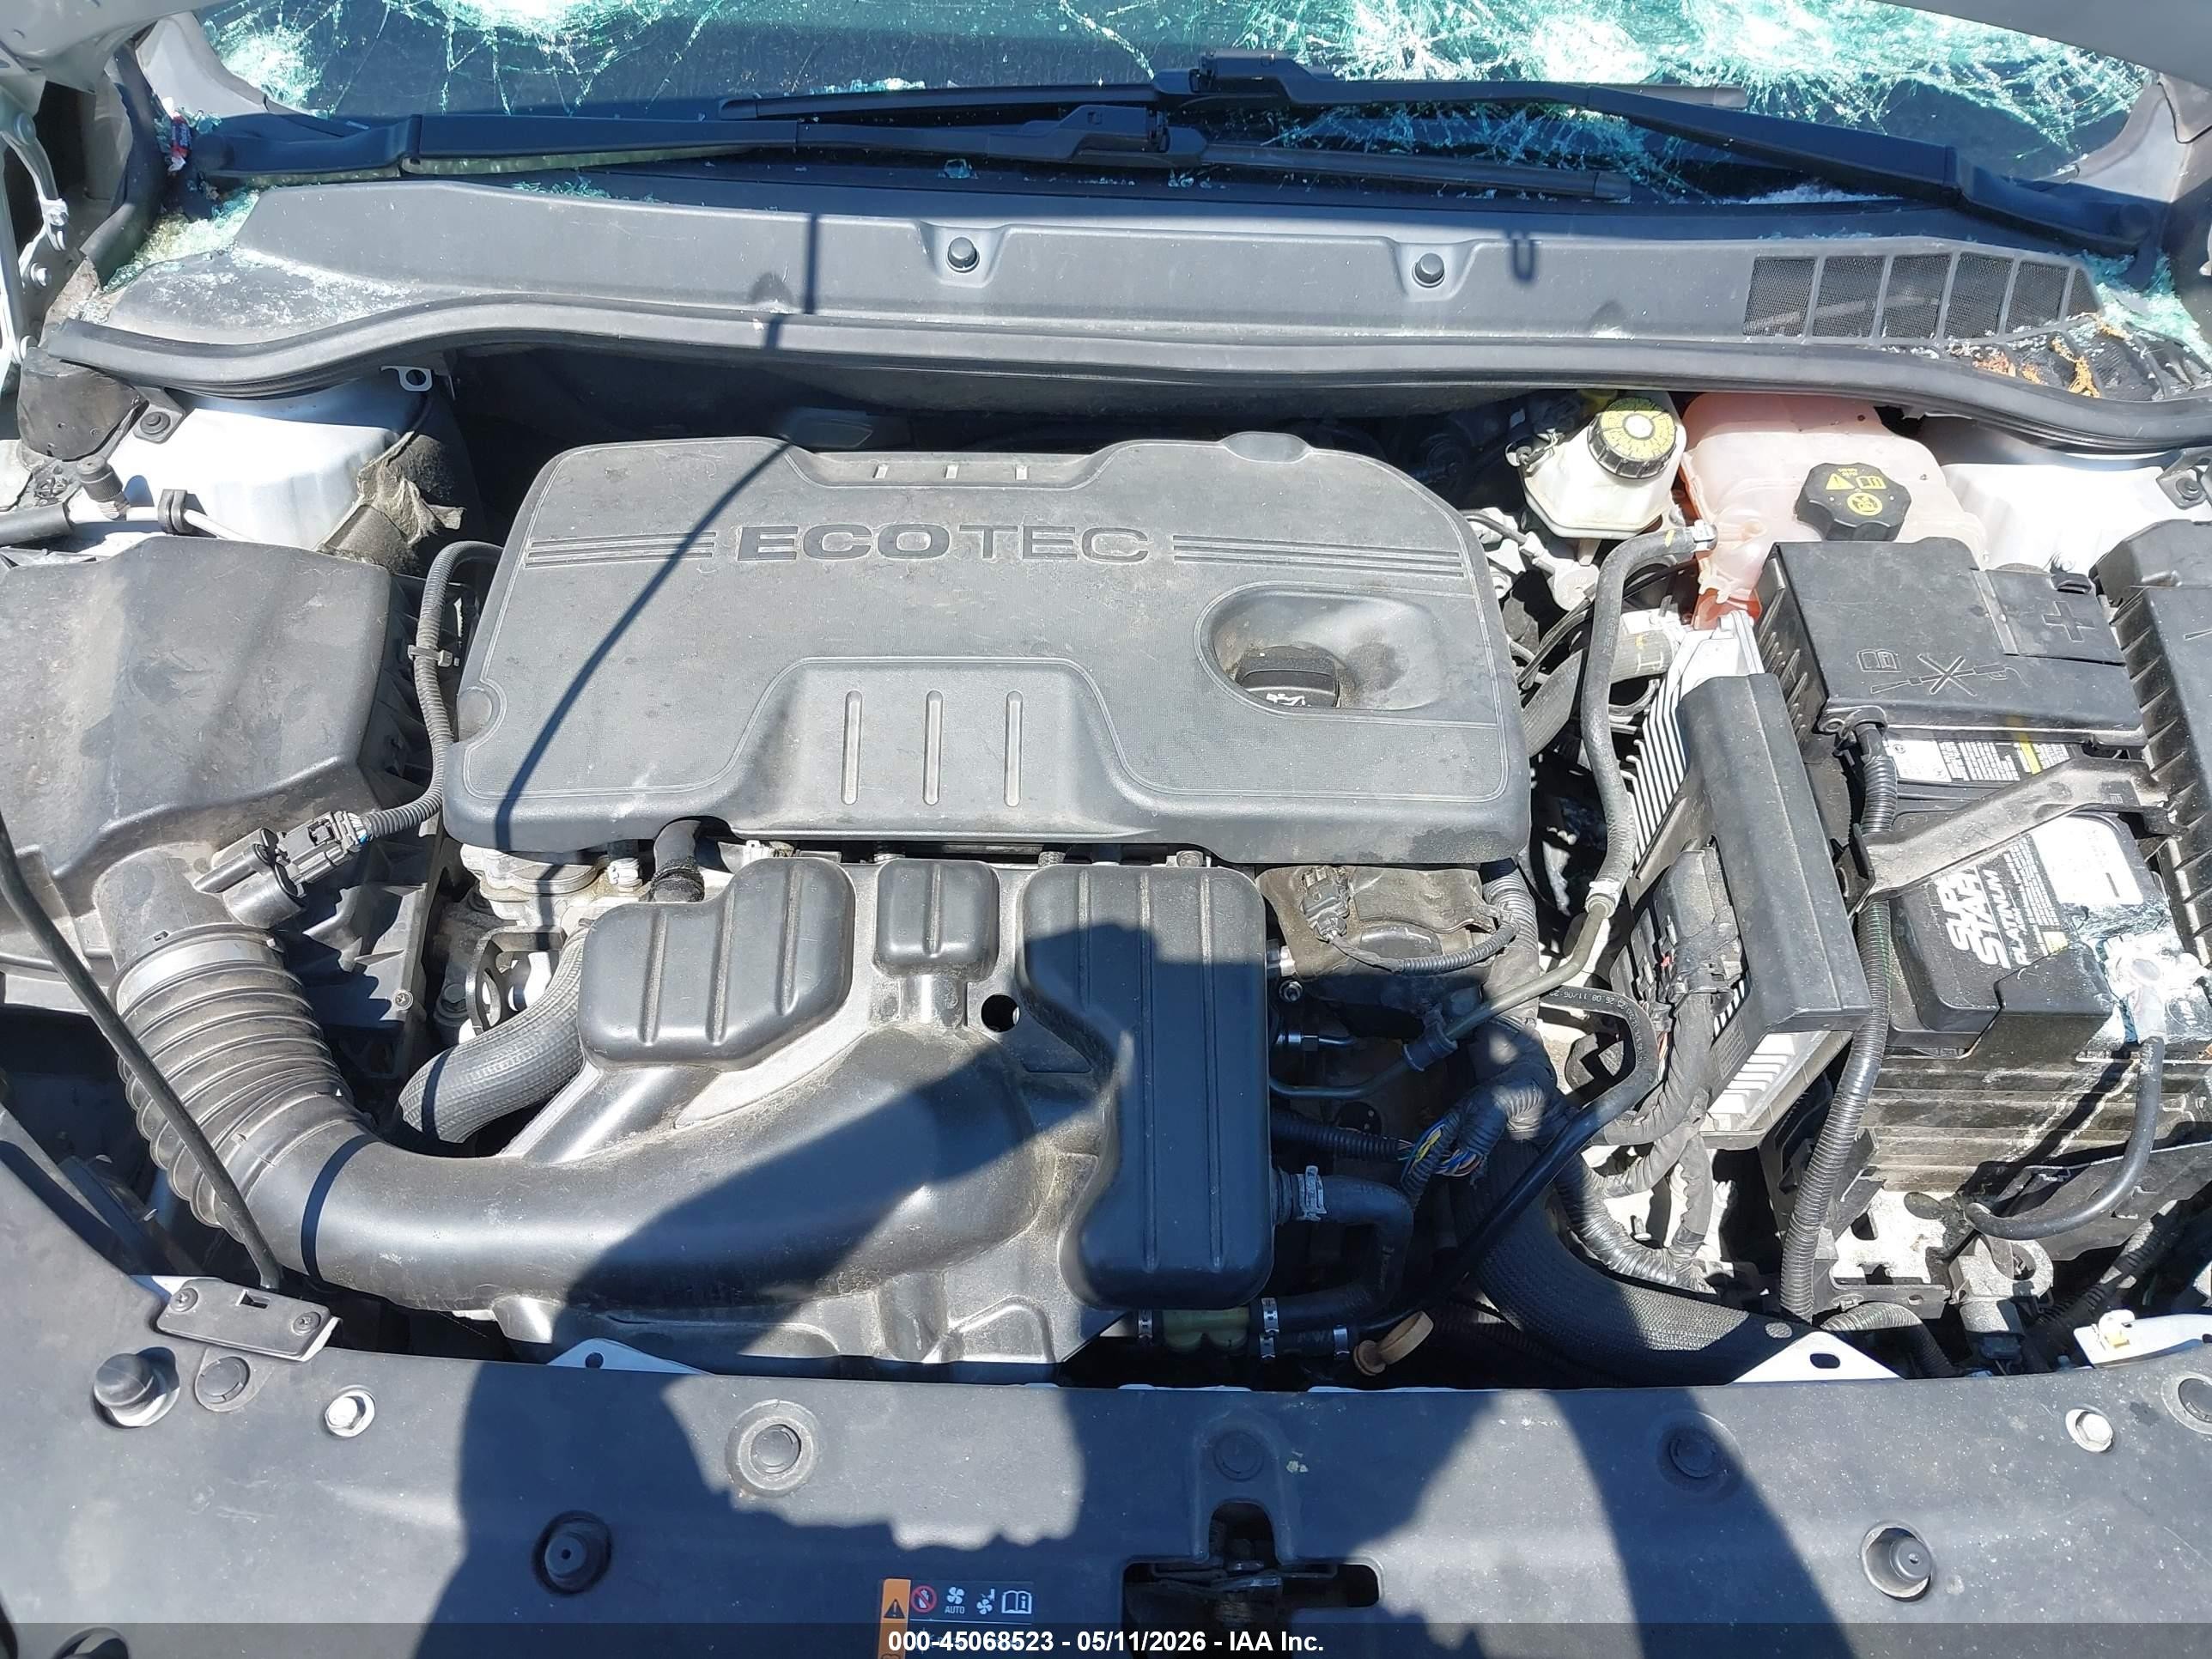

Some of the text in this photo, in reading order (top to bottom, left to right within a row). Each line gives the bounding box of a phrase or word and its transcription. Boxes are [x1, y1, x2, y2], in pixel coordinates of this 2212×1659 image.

[737, 522, 1150, 563] ECOTEC
[1935, 871, 1971, 951] SUPE
[1958, 867, 2012, 969] STAR
[1982, 868, 2032, 965] PLATINUM
[945, 1605, 965, 1614] AUTO
